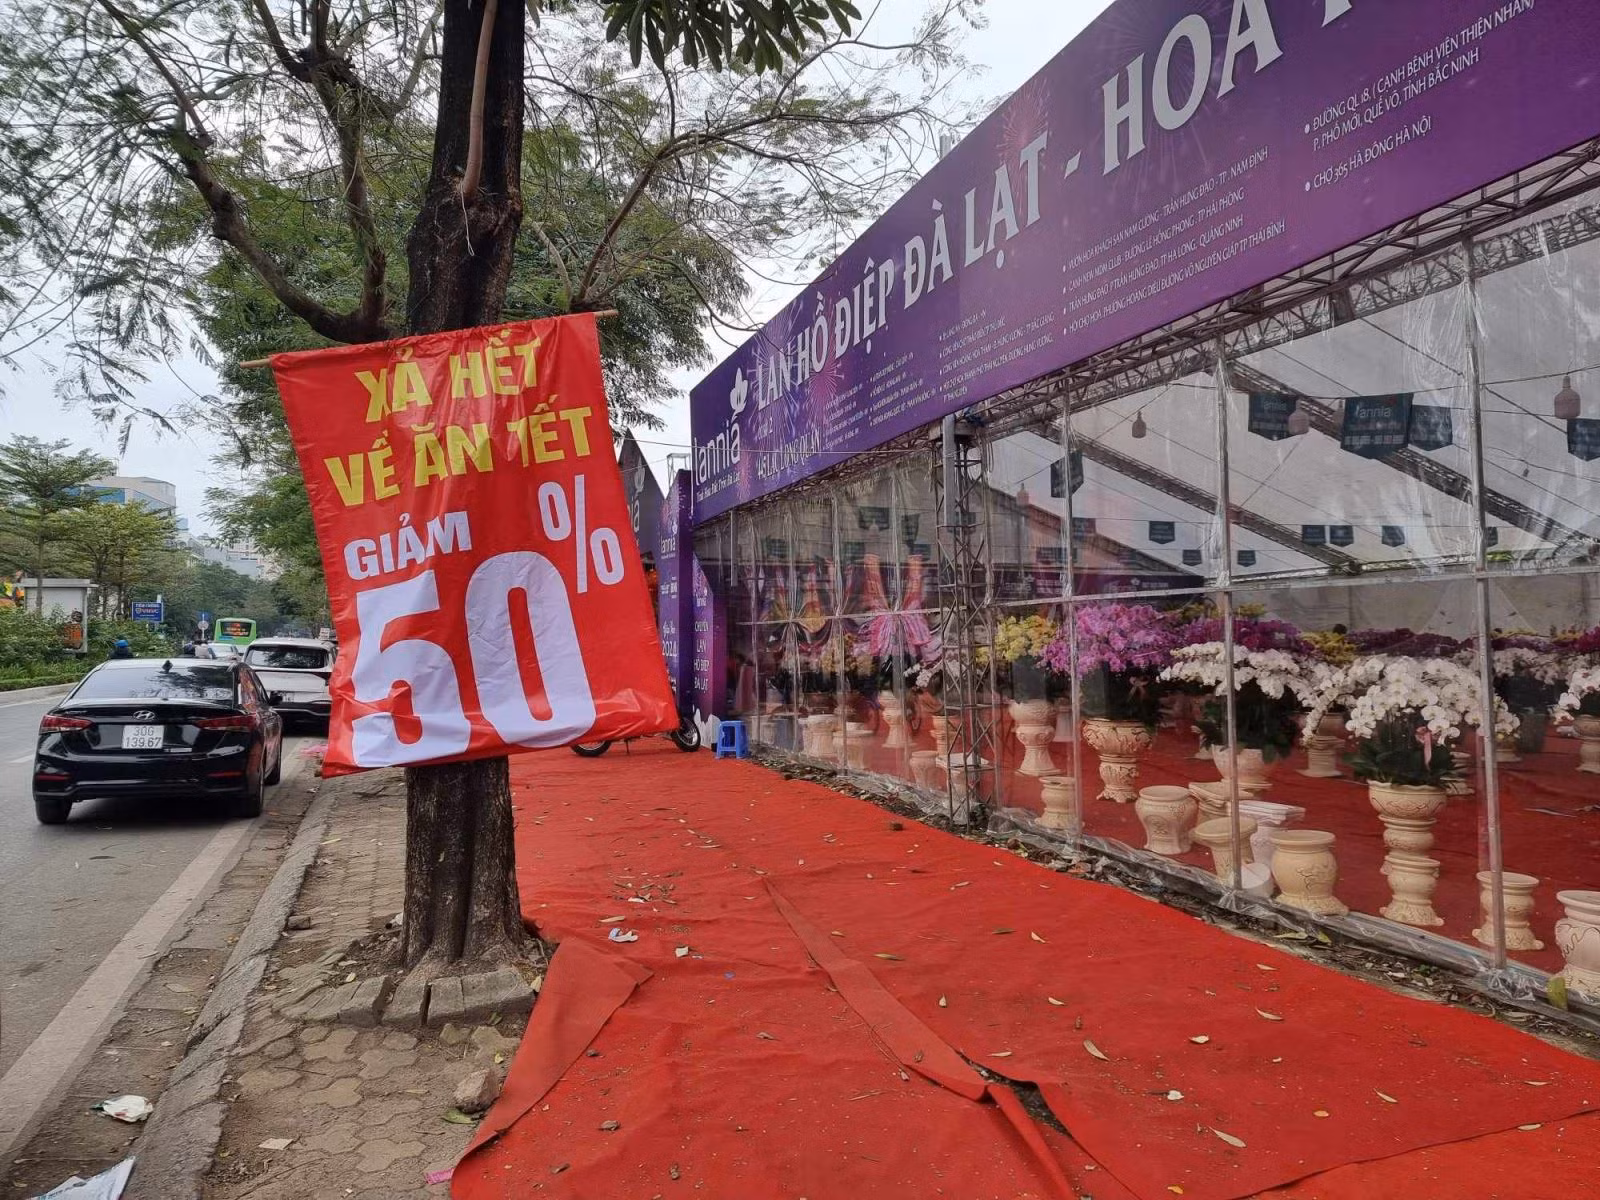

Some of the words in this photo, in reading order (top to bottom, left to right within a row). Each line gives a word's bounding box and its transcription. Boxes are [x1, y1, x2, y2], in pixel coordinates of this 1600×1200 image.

[1313, 101, 1345, 130] ĐƯỜNG
[1346, 93, 1359, 111] QL
[1377, 66, 1405, 92] CẠNH
[1407, 49, 1434, 77] BỆNH
[1435, 34, 1459, 58] VIỆN
[1460, 14, 1492, 46] THIỆN
[1322, 121, 1340, 147] PHỐ
[1364, 95, 1384, 123] QUẾ
[1403, 76, 1426, 101] TỈNH
[1428, 62, 1449, 88] BẮC
[1451, 47, 1479, 75] NINH
[1231, 159, 1248, 177] NAM
[1249, 146, 1268, 168] ĐỊNH
[1313, 166, 1333, 188] CHỢ
[1333, 162, 1348, 183] 365
[1349, 150, 1364, 170] HÀ
[1364, 135, 1394, 162] ĐÔNG
[1395, 124, 1410, 147] HÀ
[1412, 115, 1431, 139] NỘI
[758, 342, 790, 410] LAN
[797, 291, 828, 385] HỒ
[835, 257, 895, 359] ĐIỆP
[903, 199, 953, 309] ĐÀ
[965, 131, 1048, 268] LẠT
[1102, 0, 1283, 176] HOA
[1225, 213, 1244, 234] NINH
[1266, 218, 1285, 240] BÌNH
[354, 347, 432, 422] XẢ
[449, 330, 541, 397] HẾT
[324, 430, 400, 507] VỀ
[411, 422, 493, 488] ĂN
[507, 394, 592, 467] TẾT
[343, 511, 472, 580] GIẢM
